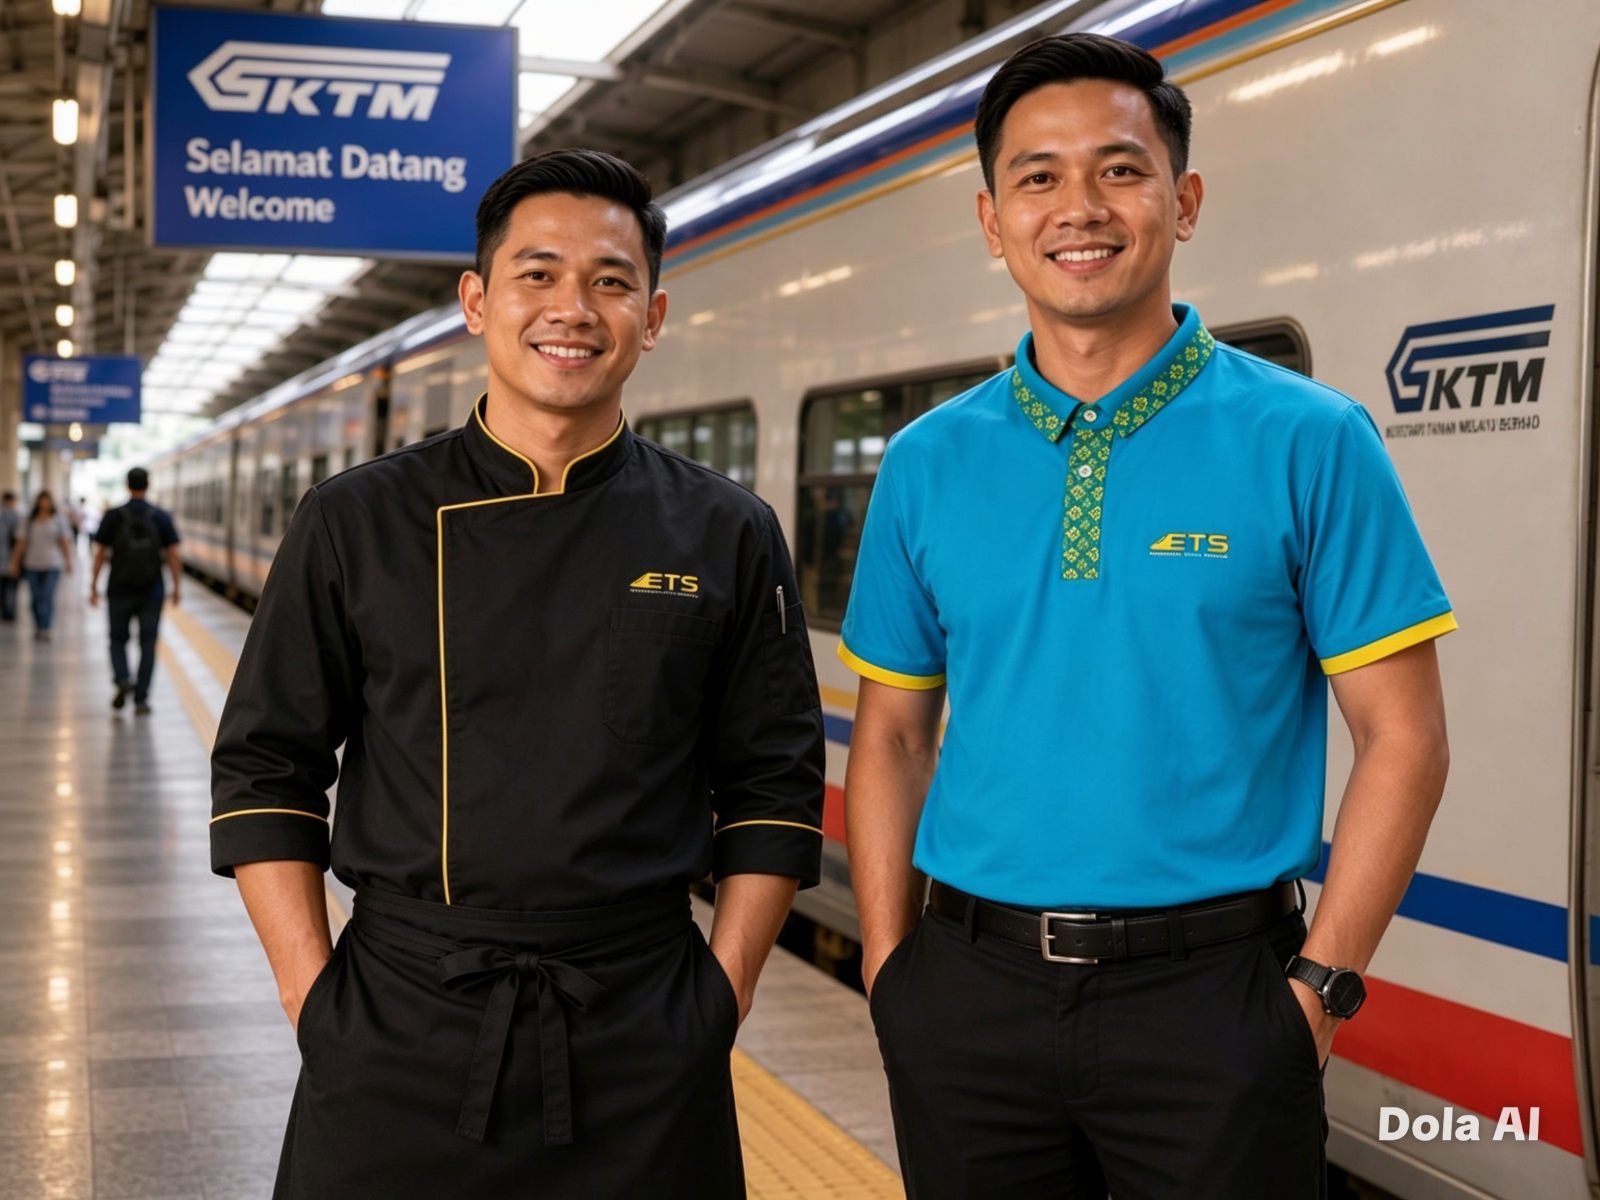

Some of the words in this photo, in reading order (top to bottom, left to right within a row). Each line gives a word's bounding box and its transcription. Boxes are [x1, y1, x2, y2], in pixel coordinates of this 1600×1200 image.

[186, 137, 332, 178] Selamat
[341, 145, 466, 192] Datang
[184, 185, 335, 223] Welcome
[1150, 533, 1229, 553] ETS
[629, 572, 699, 593] ETS
